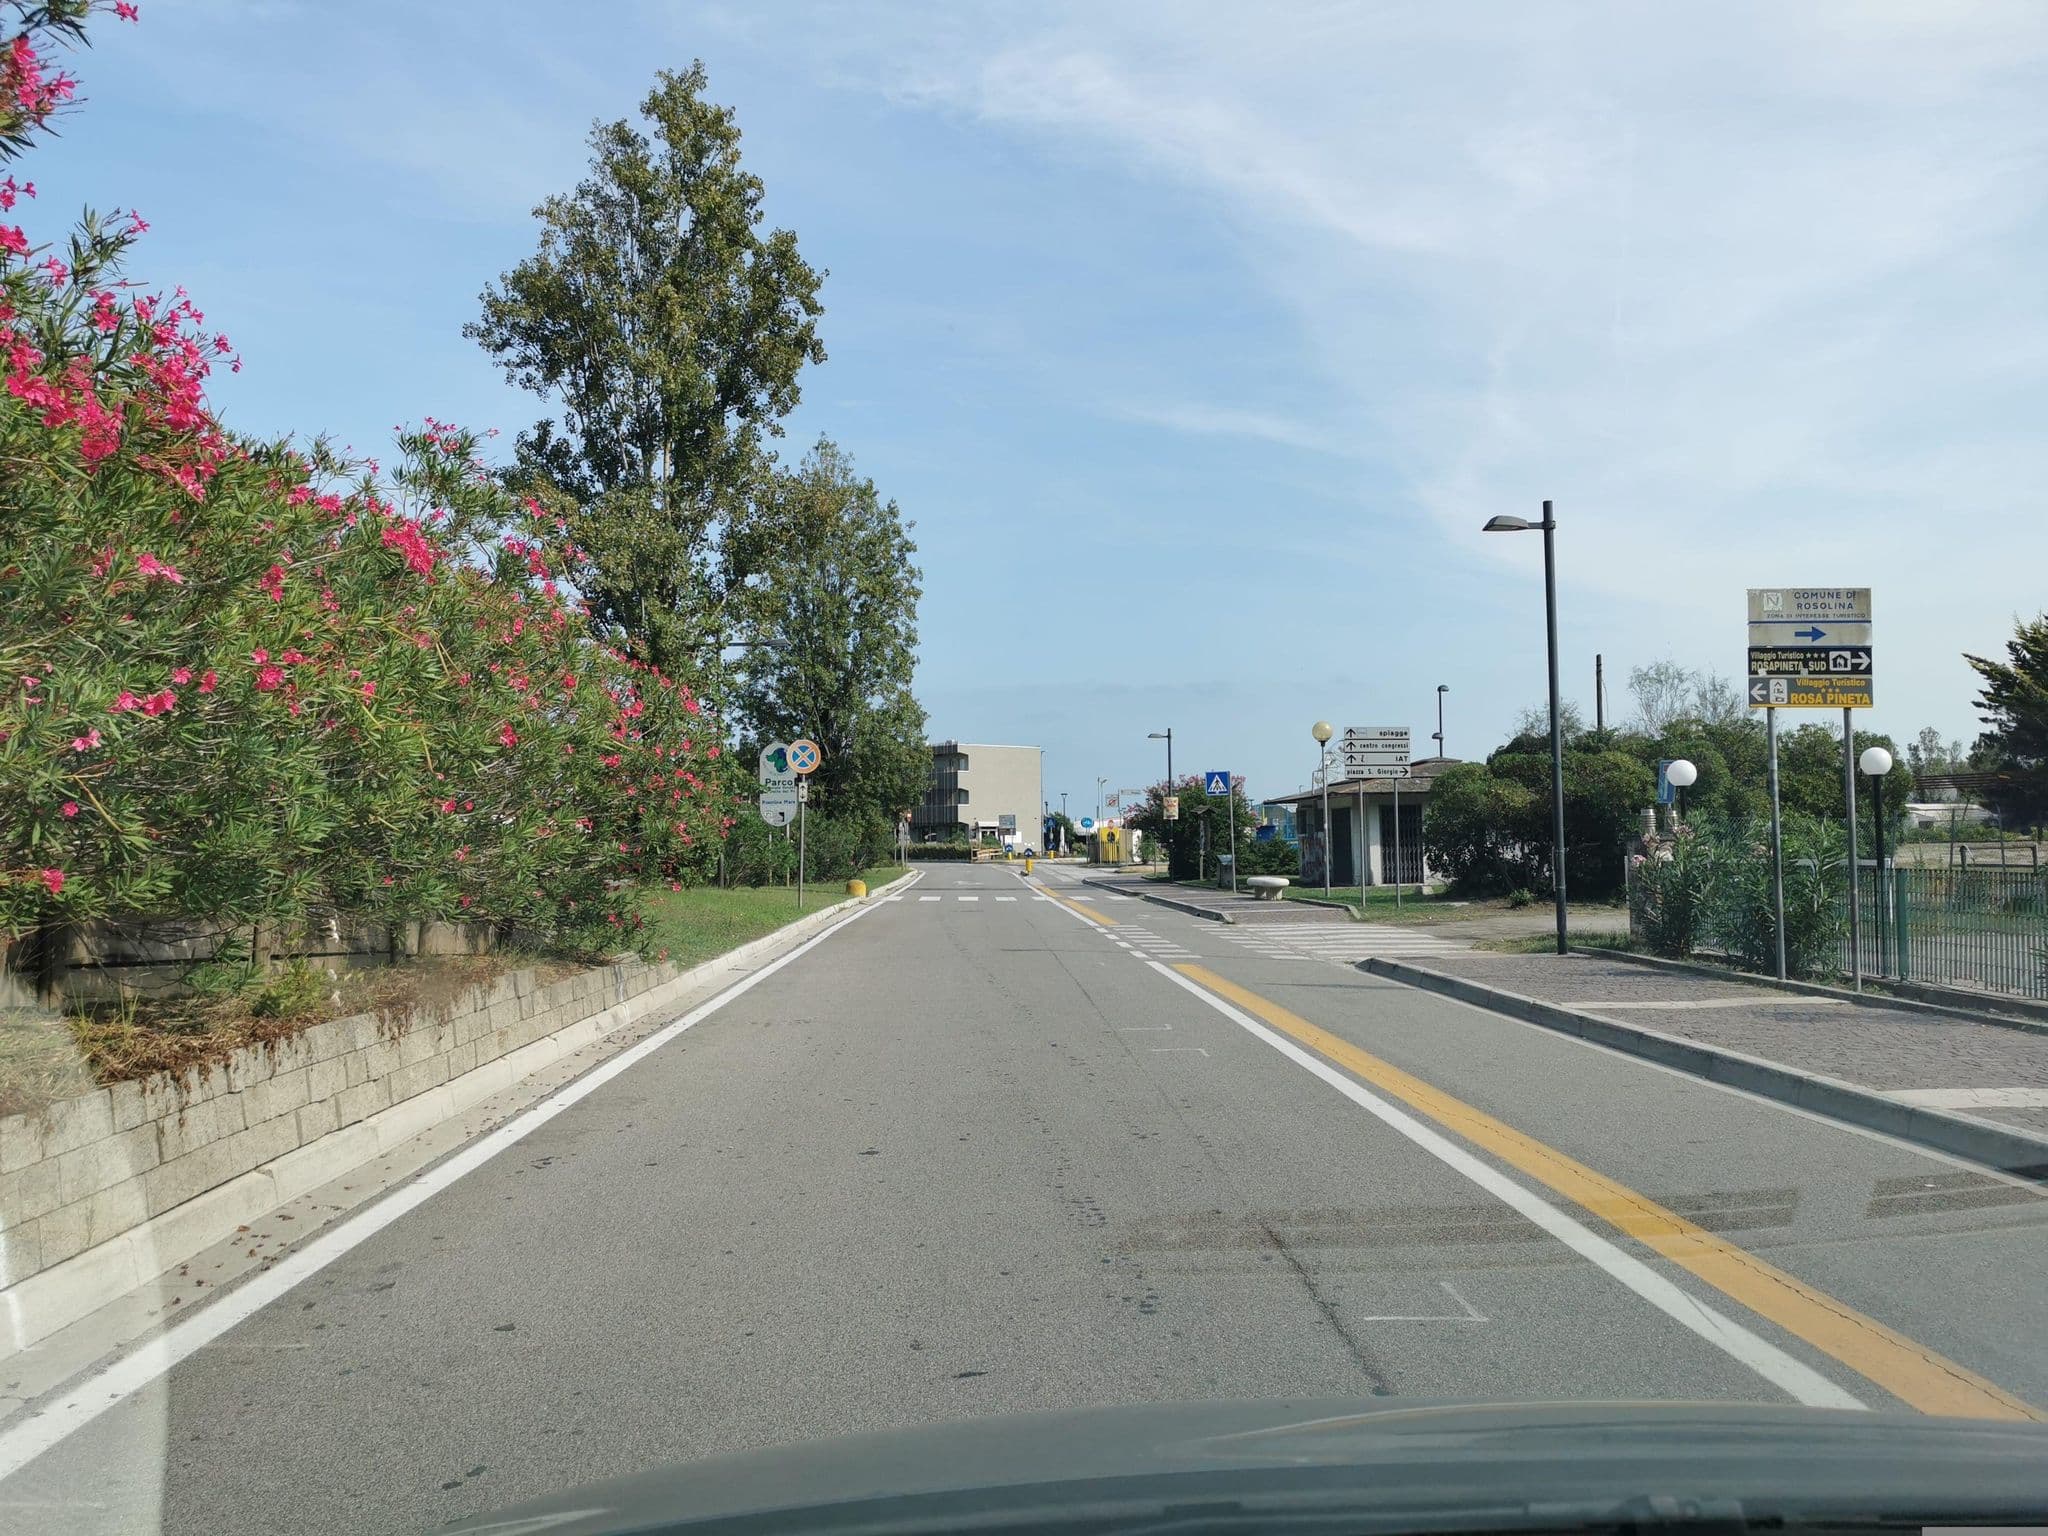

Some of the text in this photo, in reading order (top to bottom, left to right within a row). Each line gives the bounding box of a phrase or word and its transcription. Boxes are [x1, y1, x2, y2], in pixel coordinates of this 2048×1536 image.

[1794, 591, 1841, 600] COMUNE
[1797, 602, 1855, 610] ROSOLINA
[1750, 651, 1805, 661] Villaggio Turistico
[1751, 661, 1827, 671] ROSAPINETA SUD
[1796, 678, 1866, 688] Villaggio Turistico
[1790, 692, 1871, 704] ROSA PINETA
[1381, 742, 1409, 750] congressi
[765, 778, 793, 786] Parco
